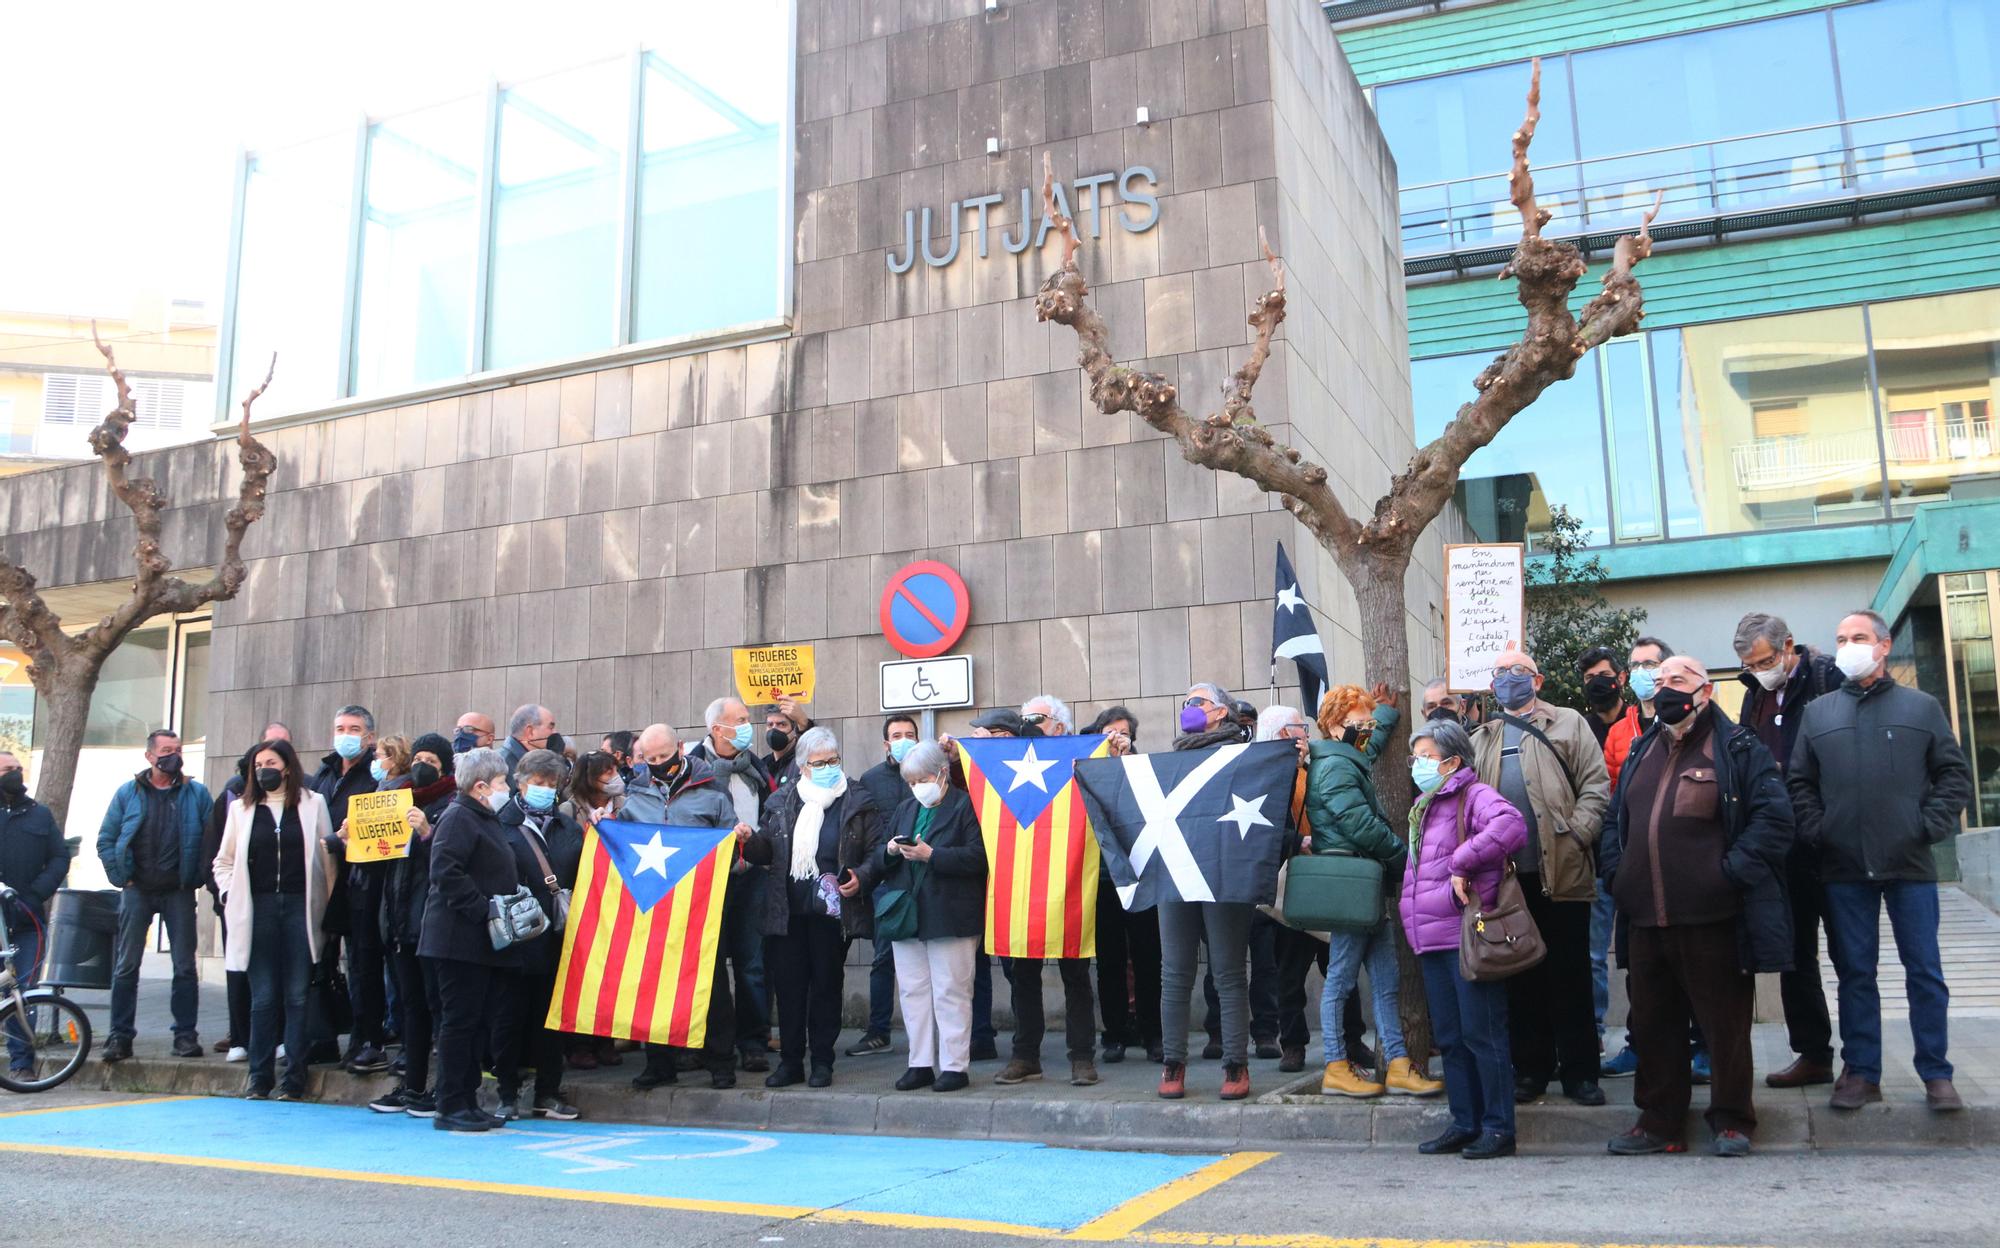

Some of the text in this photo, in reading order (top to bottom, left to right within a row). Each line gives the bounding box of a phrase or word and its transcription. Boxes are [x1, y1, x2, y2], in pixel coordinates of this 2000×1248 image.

[886, 165, 1160, 274] JUTJATS
[1469, 586, 1500, 601] fidels
[1477, 597, 1494, 607] al
[749, 649, 798, 662] FIGUERES
[748, 673, 803, 686] LLIBERTAT
[356, 794, 397, 810] FIGUERES
[356, 821, 404, 839] LLIBERTAT
